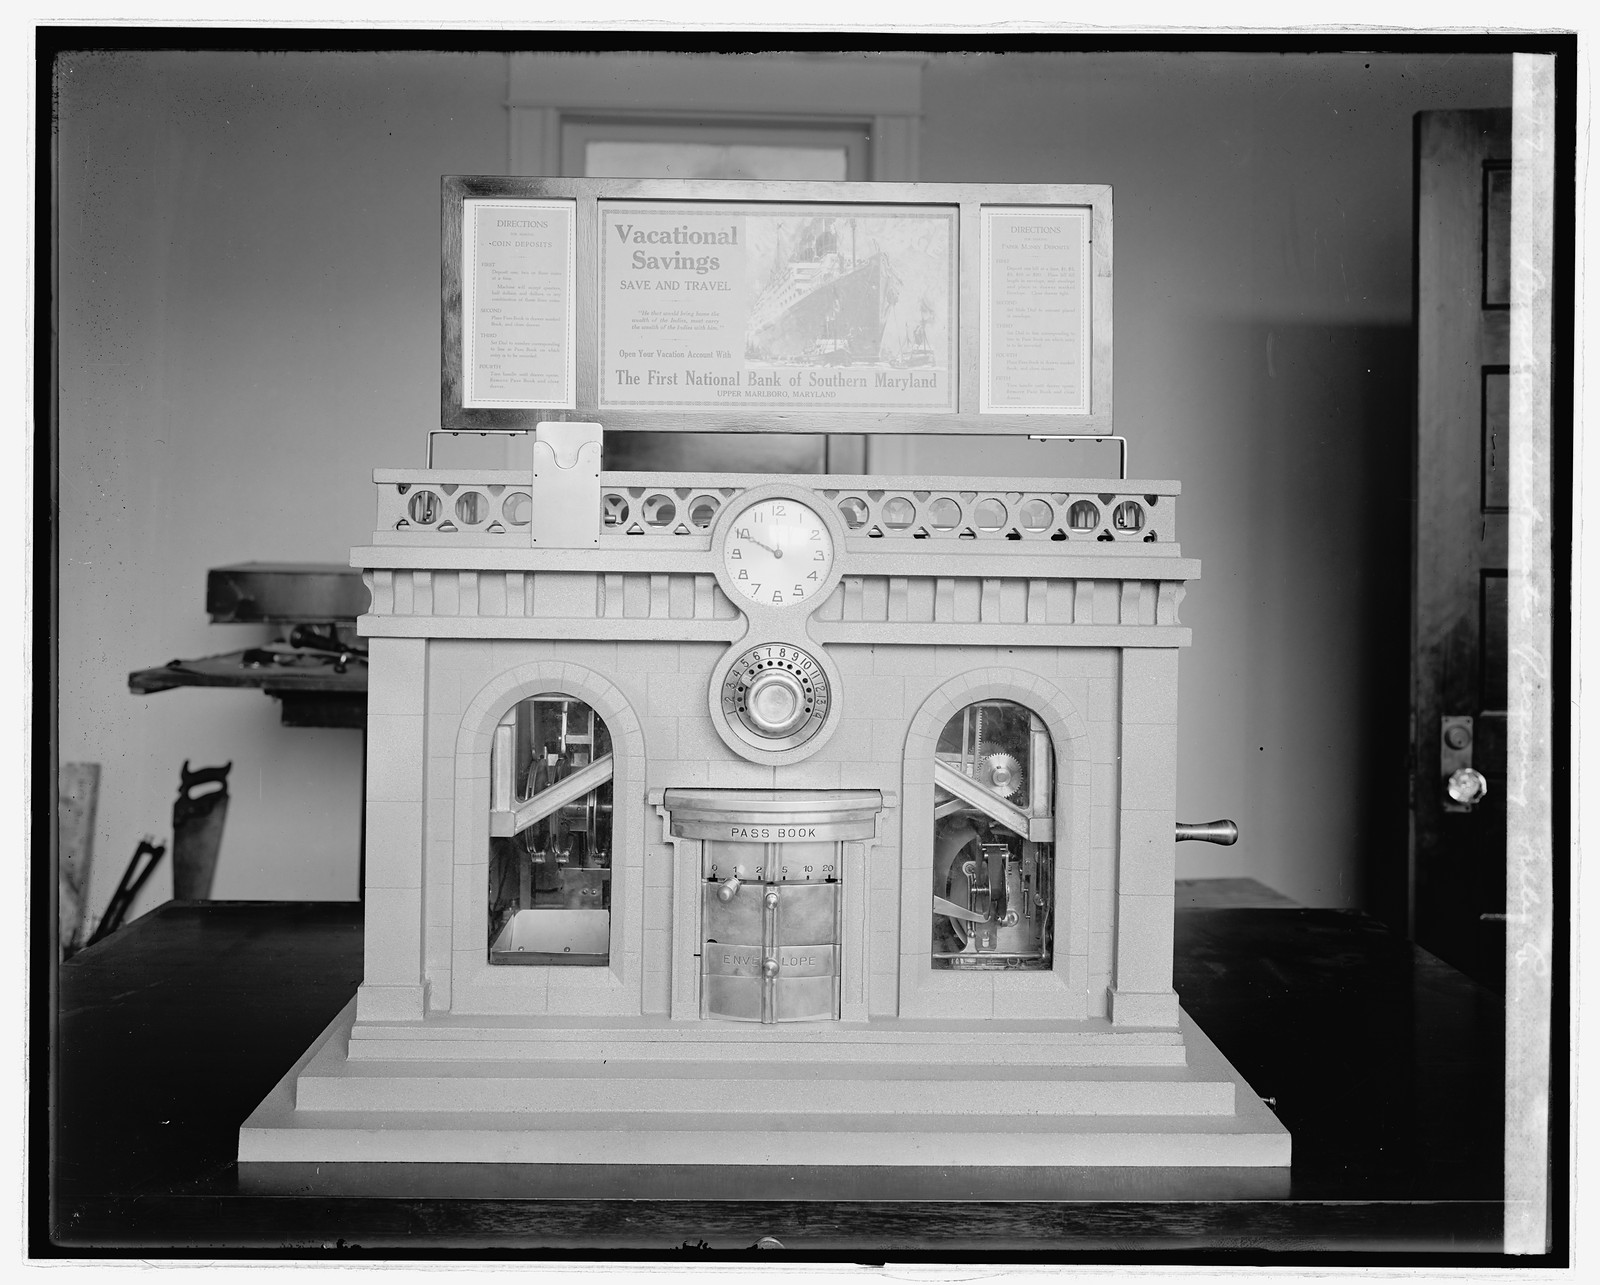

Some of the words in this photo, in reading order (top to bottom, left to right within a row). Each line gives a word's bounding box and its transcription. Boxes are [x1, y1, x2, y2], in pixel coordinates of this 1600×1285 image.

[496, 220, 548, 228] DIRECTIONS
[614, 224, 738, 245] Vacational
[1010, 226, 1062, 234] DIRECTIONS
[632, 250, 720, 275] Savings
[620, 280, 651, 290] SAVE
[656, 281, 680, 290] AND
[685, 281, 731, 291] TRAVEL
[619, 349, 636, 359] Open
[638, 350, 654, 358] Your
[656, 350, 685, 358] Vacation
[687, 350, 713, 359] Account
[716, 350, 731, 359] With
[616, 370, 640, 385] The
[648, 370, 678, 386] First
[686, 370, 741, 386] National
[748, 371, 781, 387] Bank
[789, 371, 802, 387] of
[809, 372, 867, 387] Southern
[875, 373, 937, 391] Maryland
[772, 506, 786, 516] 12
[754, 512, 763, 523] 11
[736, 528, 750, 539] 10
[810, 530, 821, 540] 2
[731, 549, 742, 559] 9
[813, 551, 824, 561] 3
[738, 569, 748, 580] 8
[807, 571, 818, 581] 4
[751, 583, 761, 595] 7
[793, 584, 804, 596] 5
[772, 590, 783, 602] 6
[753, 651, 760, 660] 6
[766, 648, 771, 657] 7
[780, 648, 786, 657] 8
[792, 652, 799, 661] 9
[740, 658, 749, 668] 5
[800, 658, 812, 669] 10
[732, 669, 742, 677] 4
[810, 670, 820, 679] 11
[815, 682, 825, 692] 12
[816, 695, 826, 705] 13
[813, 709, 824, 719] 14
[731, 828, 770, 838] PASS
[777, 828, 816, 838] BOOK
[822, 864, 834, 872] 20
[723, 954, 816, 967] ENVELOPE
